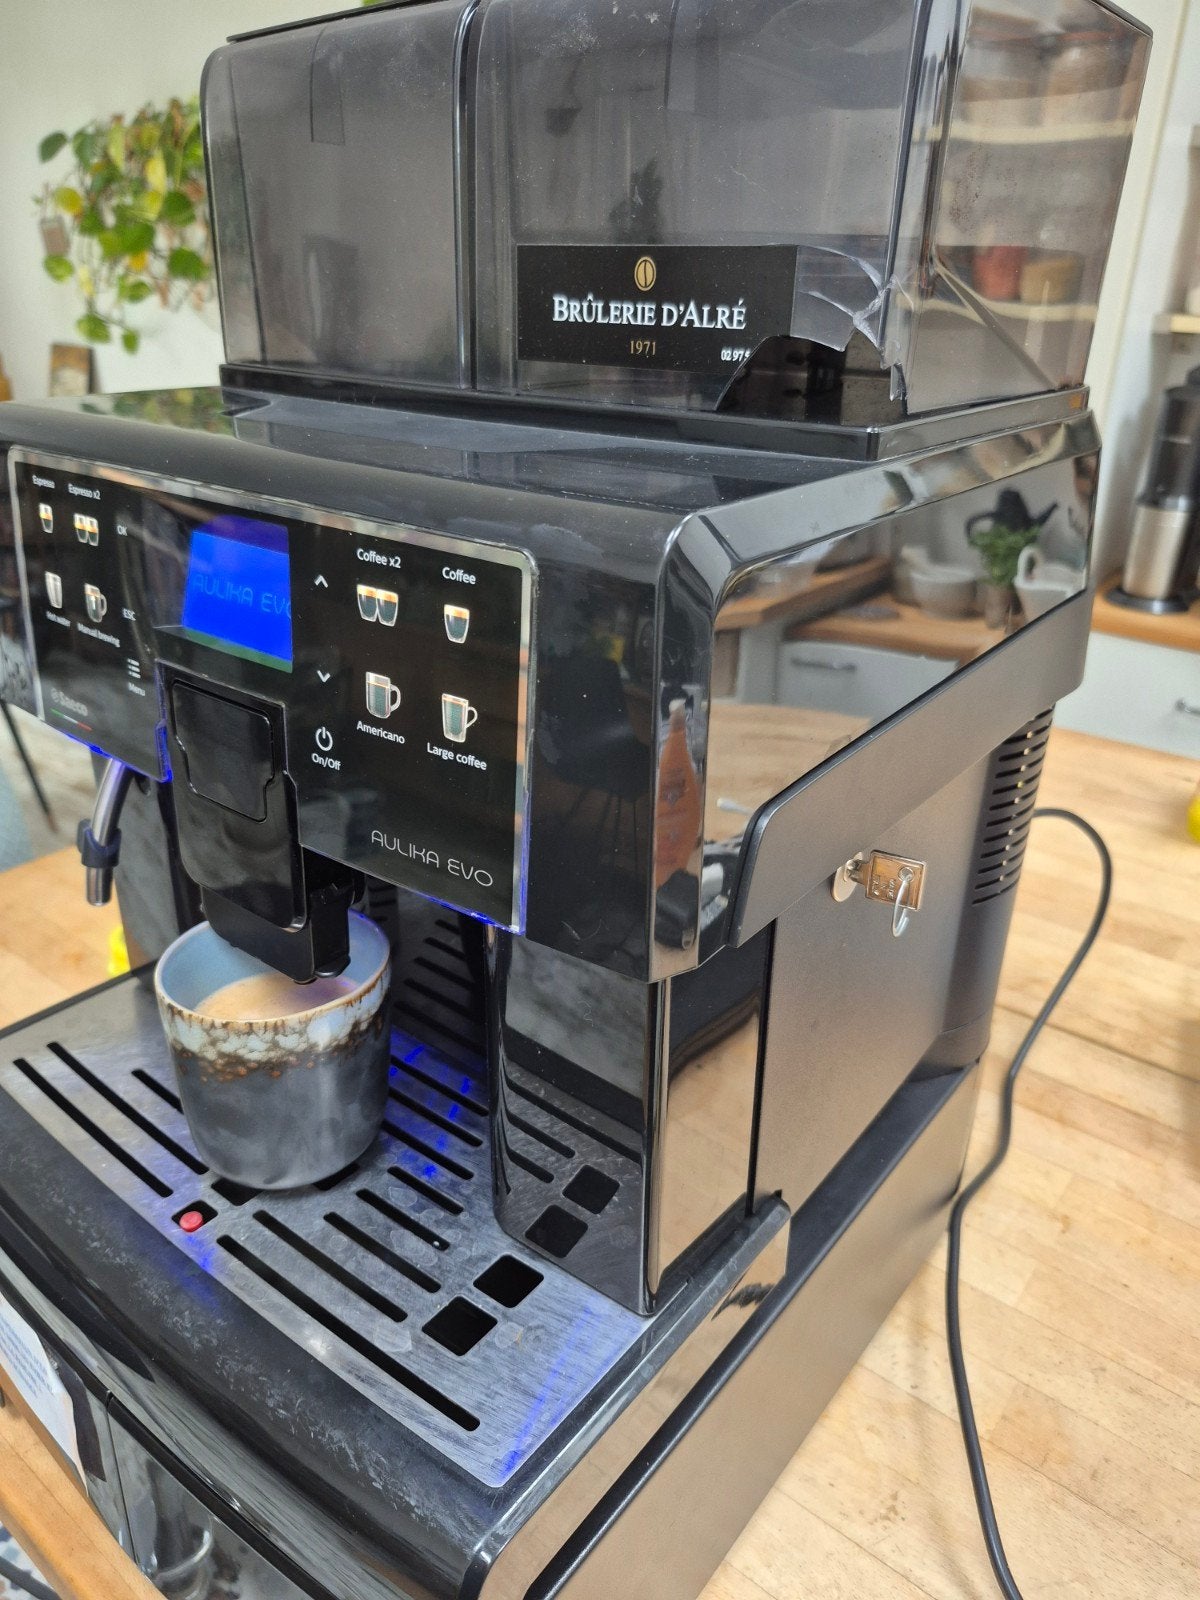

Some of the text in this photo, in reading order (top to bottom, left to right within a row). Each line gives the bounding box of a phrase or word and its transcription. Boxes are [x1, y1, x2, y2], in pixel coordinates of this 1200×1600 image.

[629, 340, 657, 356] 1971
[68, 482, 93, 498] Espresso
[117, 525, 128, 537] OK
[356, 548, 402, 569] Coffee x2
[442, 566, 477, 585] Coffee
[193, 574, 254, 606] AULIKA
[122, 608, 136, 621] ESC
[356, 720, 405, 744] Americano
[311, 752, 342, 771] On/Off
[427, 742, 487, 771] Large coffee
[371, 830, 493, 887] AULIKA EVO
